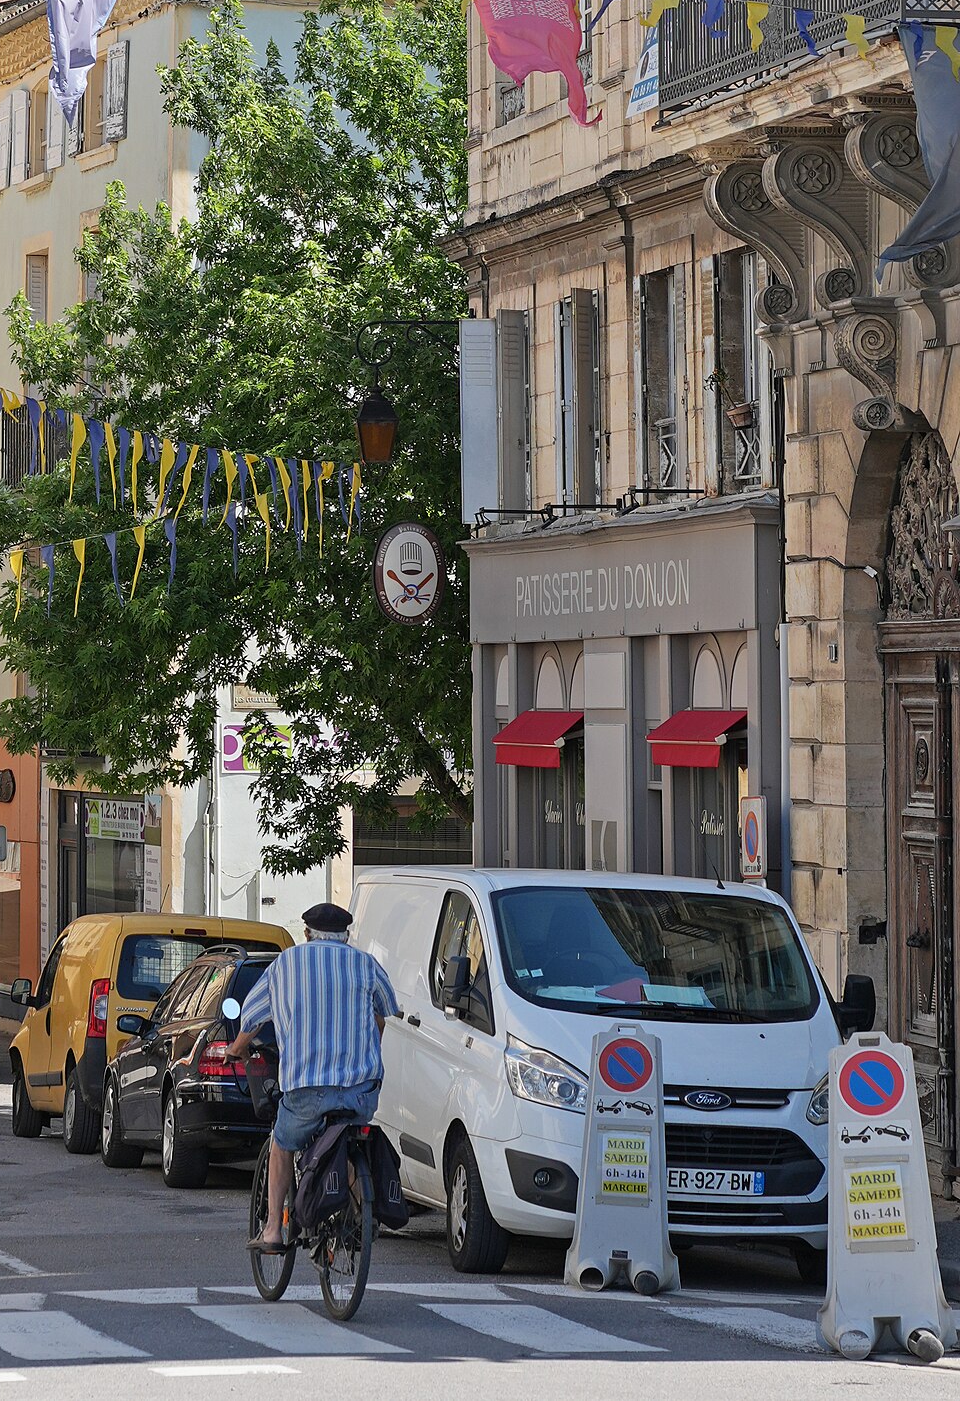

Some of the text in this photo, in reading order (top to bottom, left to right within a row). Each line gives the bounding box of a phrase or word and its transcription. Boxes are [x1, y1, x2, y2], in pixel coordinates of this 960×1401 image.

[516, 559, 690, 617] PATISSERIE DU DONJON
[101, 801, 117, 819] 1.2.3
[118, 803, 129, 820] chez
[696, 1092, 722, 1105] Ford
[607, 1139, 645, 1150] MARDI
[604, 1153, 648, 1164] SAMEDI
[668, 1170, 751, 1191] ER-927-BW
[851, 1172, 897, 1186] MARDI
[603, 1182, 647, 1193] MARCHE
[849, 1188, 902, 1203] SAMEDI
[852, 1224, 906, 1238] MARCHE
